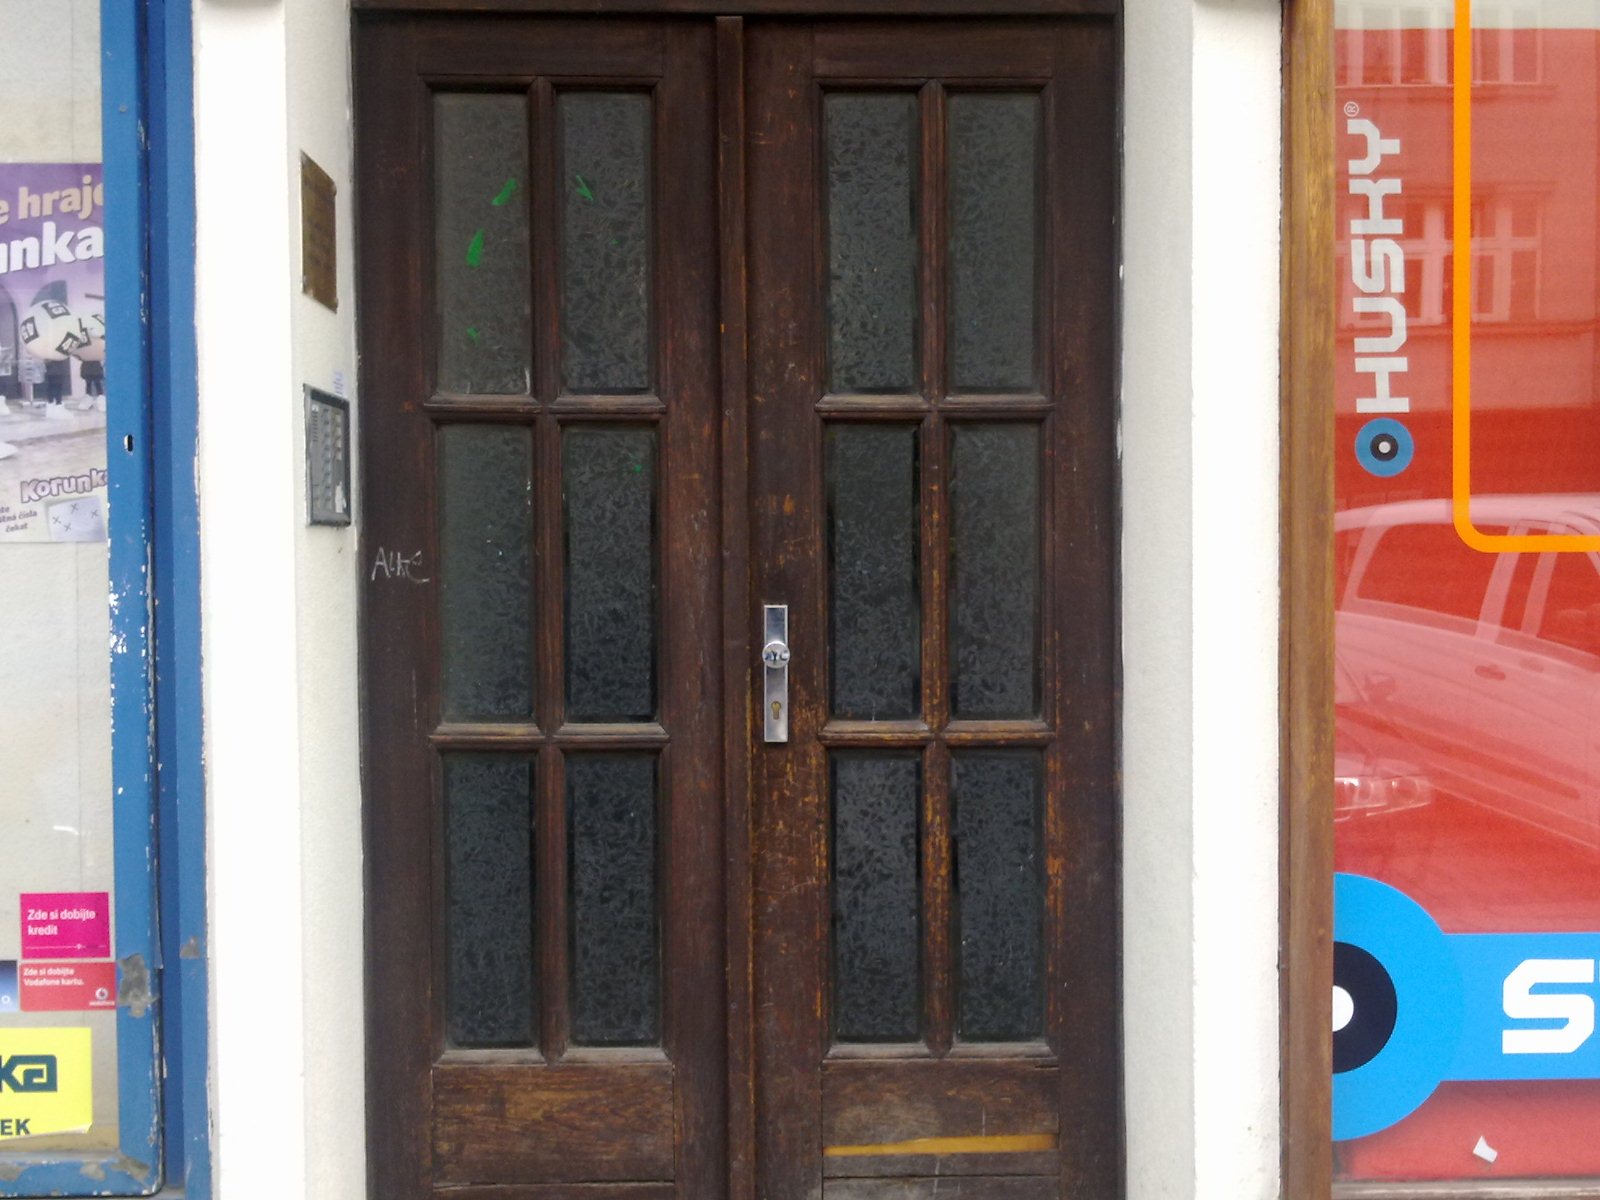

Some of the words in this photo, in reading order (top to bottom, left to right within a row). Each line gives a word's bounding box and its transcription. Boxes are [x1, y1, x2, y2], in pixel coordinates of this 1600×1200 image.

[1347, 118, 1410, 413] HUSKY
[20, 468, 108, 503] Korunk
[27, 909, 48, 920] Zde
[49, 909, 59, 920] si
[60, 909, 96, 921] dobijte
[27, 925, 58, 936] kredit
[23, 967, 38, 976] Zde
[39, 968, 46, 976] si
[23, 978, 60, 987] Vodafone
[1502, 957, 1600, 1054] S
